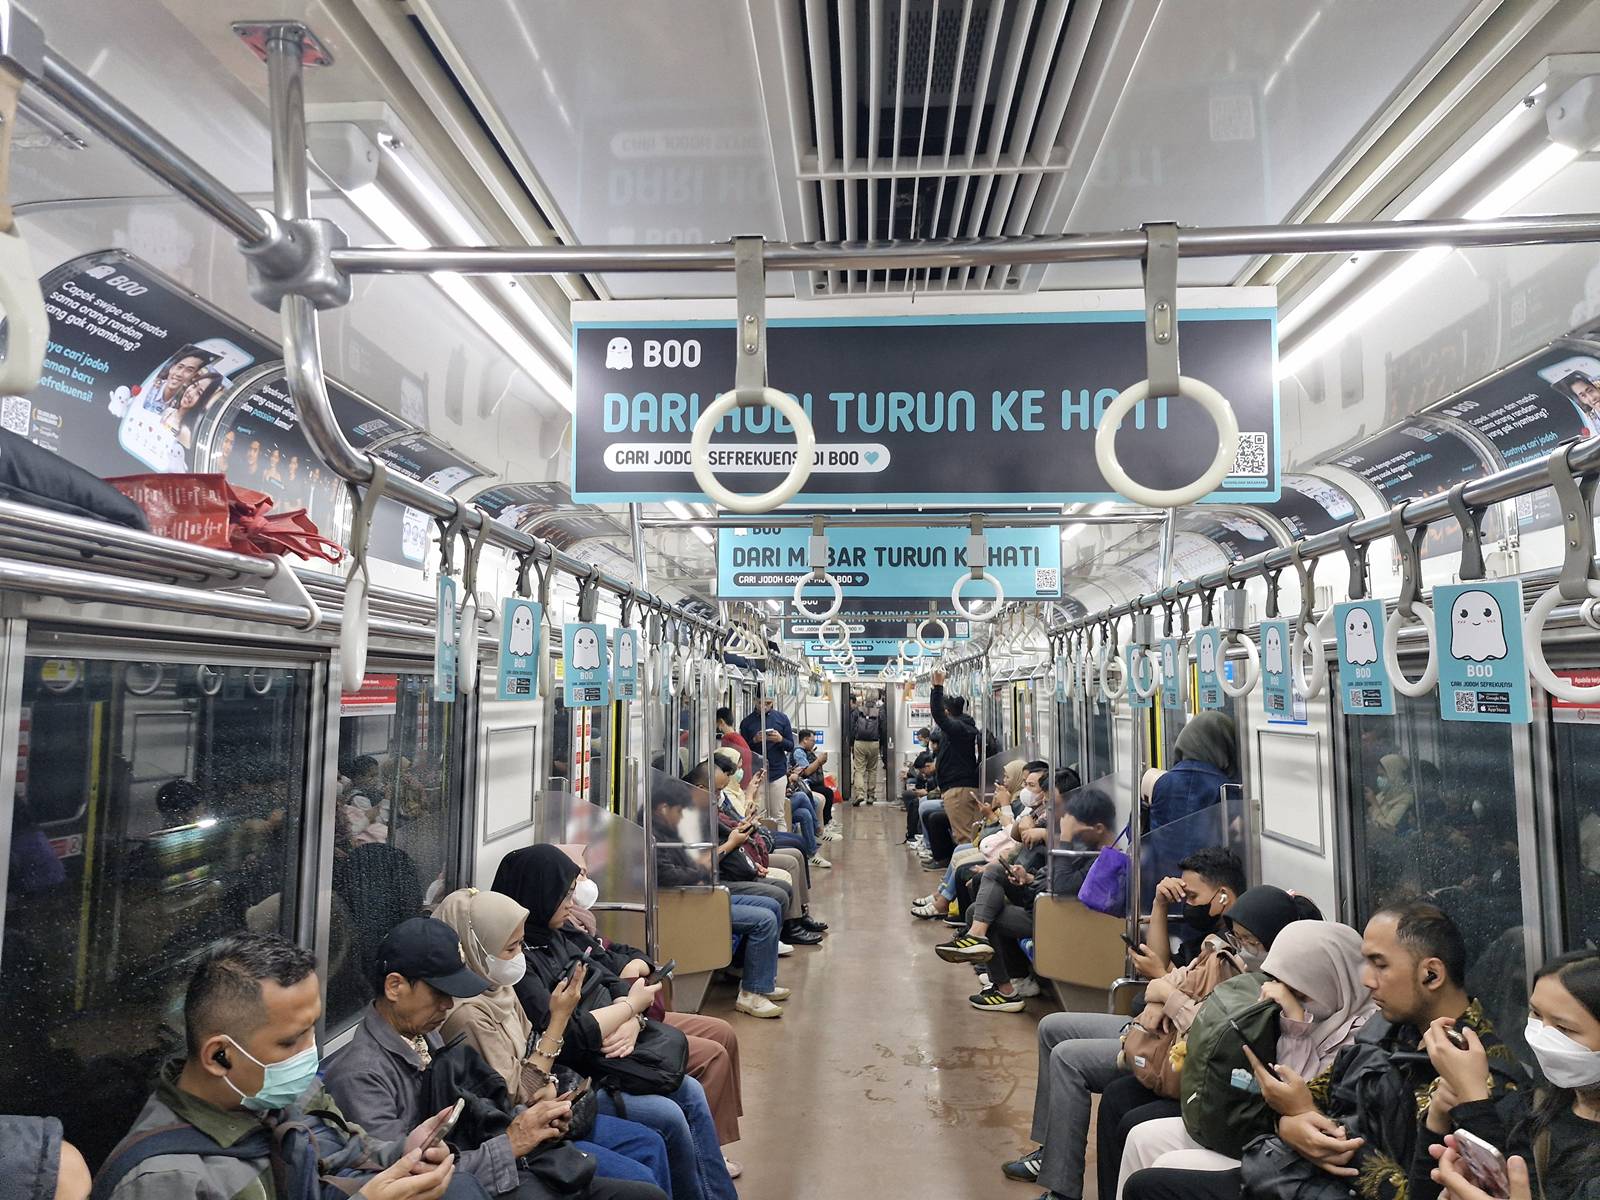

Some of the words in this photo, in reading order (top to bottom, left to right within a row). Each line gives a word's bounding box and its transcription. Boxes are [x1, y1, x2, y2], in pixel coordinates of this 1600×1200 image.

[106, 275, 148, 296] BOO
[50, 291, 80, 309] sama
[79, 305, 109, 325] orang
[107, 318, 143, 340] random
[62, 281, 95, 302] Capek
[93, 298, 123, 316] swipe
[121, 312, 141, 325] dan
[139, 321, 168, 338] match
[65, 314, 87, 328] gak
[85, 320, 141, 351] nyambung?
[63, 348, 85, 363] cari
[79, 354, 110, 373] jodoh
[643, 340, 701, 368] BOO
[42, 358, 71, 376] eman
[71, 366, 95, 385] baru
[603, 392, 699, 433] DARI
[828, 391, 976, 433] TURUN
[992, 389, 1046, 432] KE
[1494, 414, 1515, 427] orang
[1512, 404, 1538, 418] random
[1504, 401, 1518, 411] dan
[1487, 427, 1504, 440] yang
[1501, 420, 1515, 433] gak
[1513, 407, 1549, 429] nyambung?
[1501, 444, 1528, 458] Saatnya
[1526, 436, 1541, 449] cari
[1538, 431, 1559, 446] jodoh
[615, 450, 648, 465] CARI
[654, 450, 692, 465] JODO
[708, 450, 798, 466] SEFREKUENS
[828, 451, 858, 466] BOO
[732, 547, 781, 567] DARI
[788, 547, 866, 567] MBAR
[873, 545, 946, 568] TURUN
[988, 547, 1040, 567] HATI
[738, 575, 756, 584] CARI
[758, 575, 782, 584] JODOH
[1467, 664, 1493, 677] BOO
